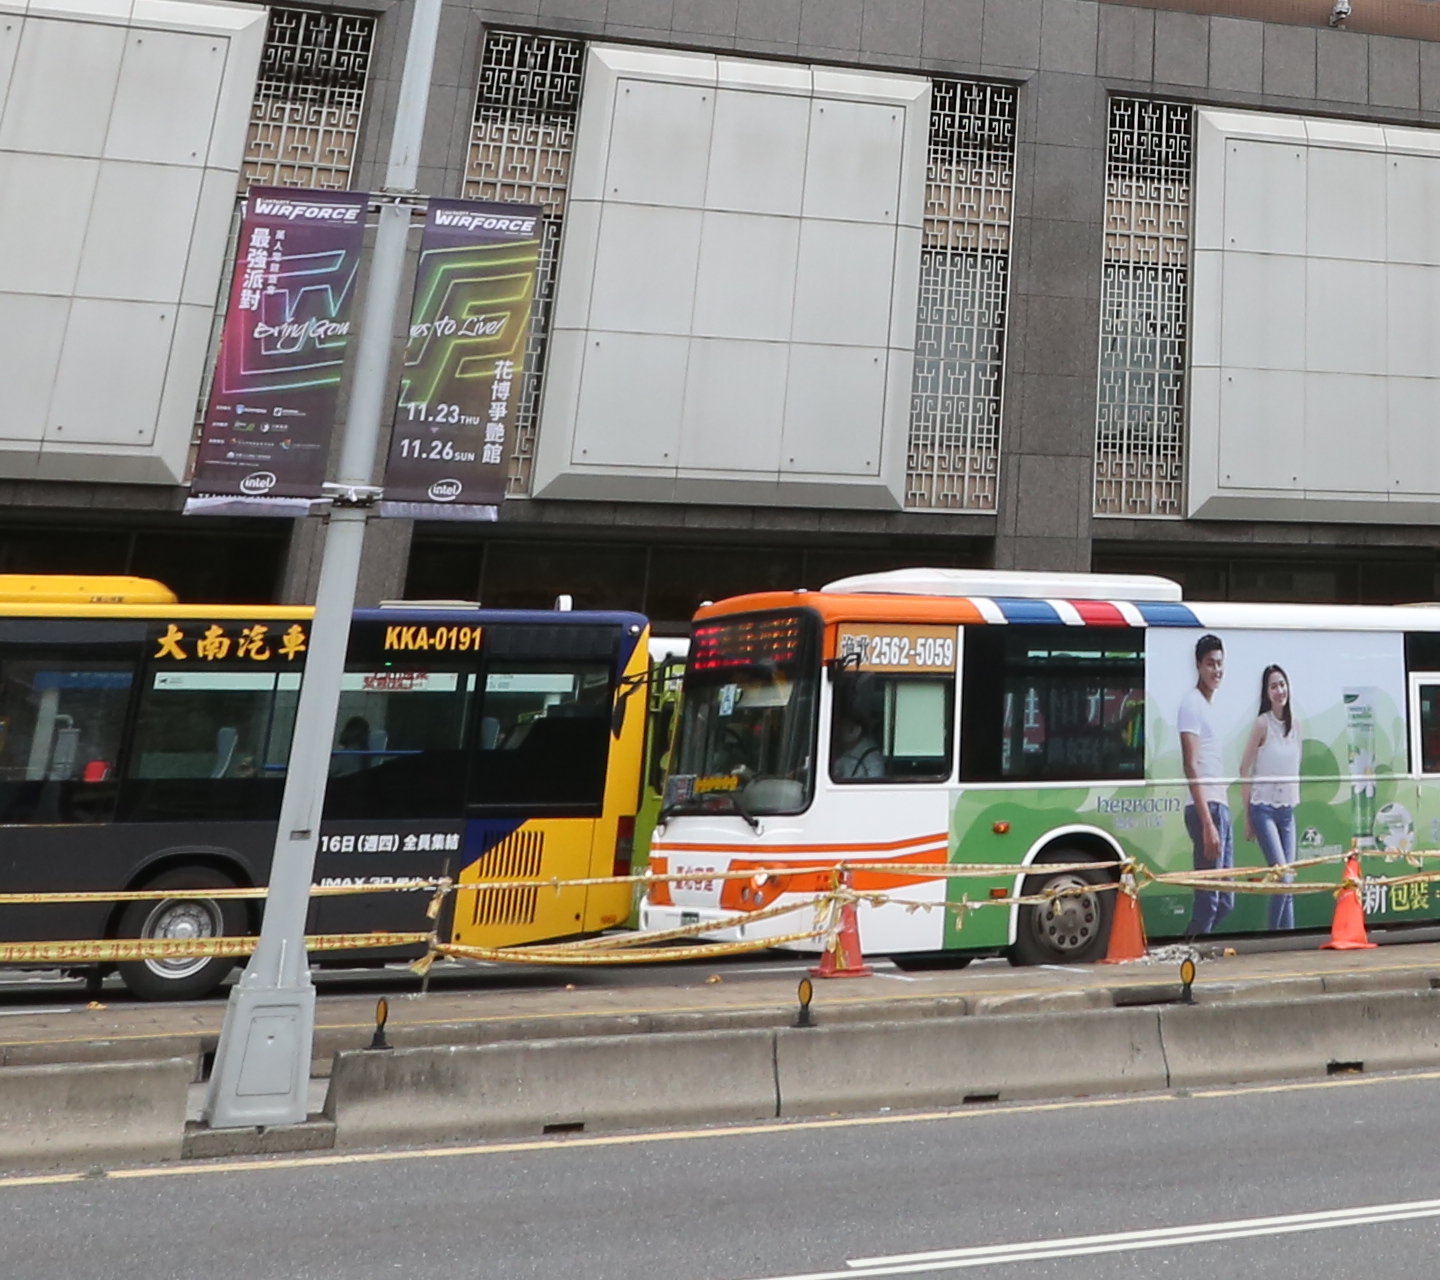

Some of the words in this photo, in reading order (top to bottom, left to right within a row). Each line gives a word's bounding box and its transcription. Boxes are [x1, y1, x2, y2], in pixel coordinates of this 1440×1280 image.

[254, 197, 362, 220] WIRFORCE
[434, 209, 536, 231] WIRFORCE
[239, 227, 271, 311] 最強派對
[433, 315, 457, 337] to
[406, 401, 461, 425] 11.23
[459, 415, 481, 426] THU
[399, 438, 454, 460] 11.26
[453, 451, 476, 462] SUN
[153, 623, 308, 661] 大南汽車
[383, 626, 483, 651] KKA-0191
[870, 635, 954, 666] 2562-5059
[402, 832, 460, 852] 全員集結
